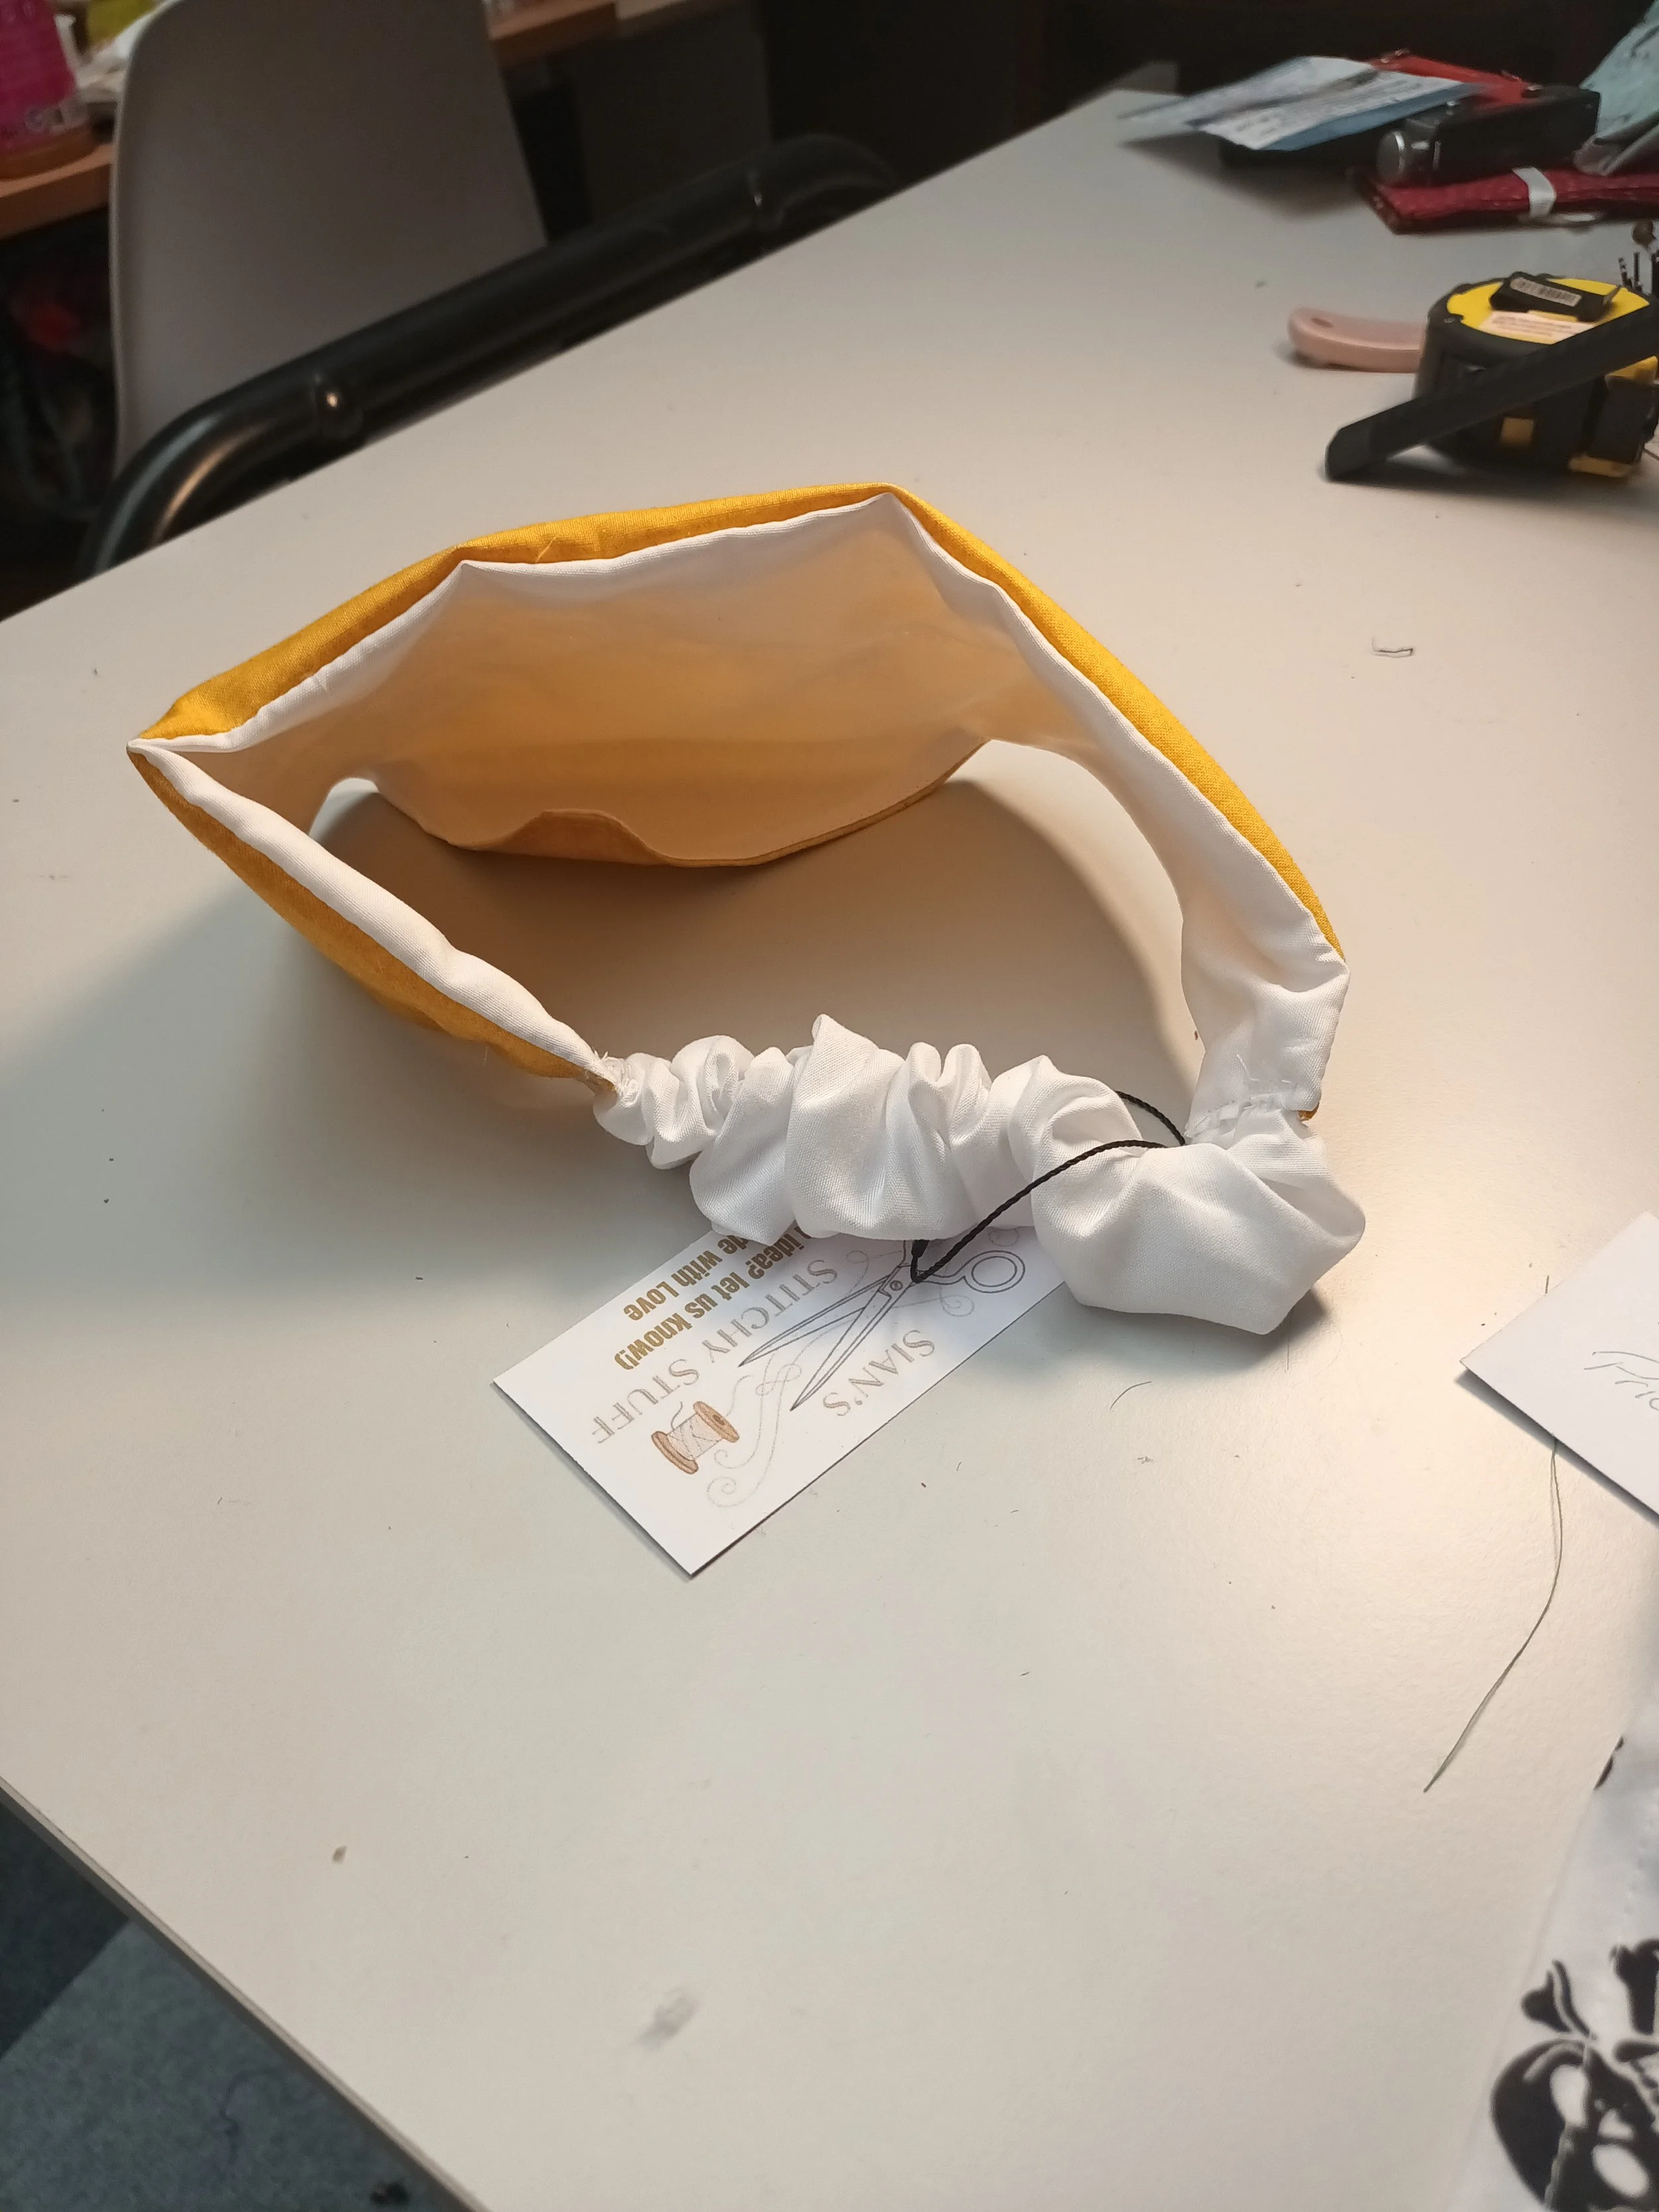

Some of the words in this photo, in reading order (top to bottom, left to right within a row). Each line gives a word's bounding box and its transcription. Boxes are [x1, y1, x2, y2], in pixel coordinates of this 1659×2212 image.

[670, 1250, 723, 1287] with
[745, 1233, 805, 1280] idea?
[623, 1281, 680, 1321] Love
[684, 1293, 718, 1319] us
[711, 1271, 750, 1301] let
[701, 1259, 838, 1363] STITCHY
[614, 1312, 693, 1370] know!)
[822, 1329, 935, 1416] SIAN'S
[592, 1359, 700, 1443] STUFF
